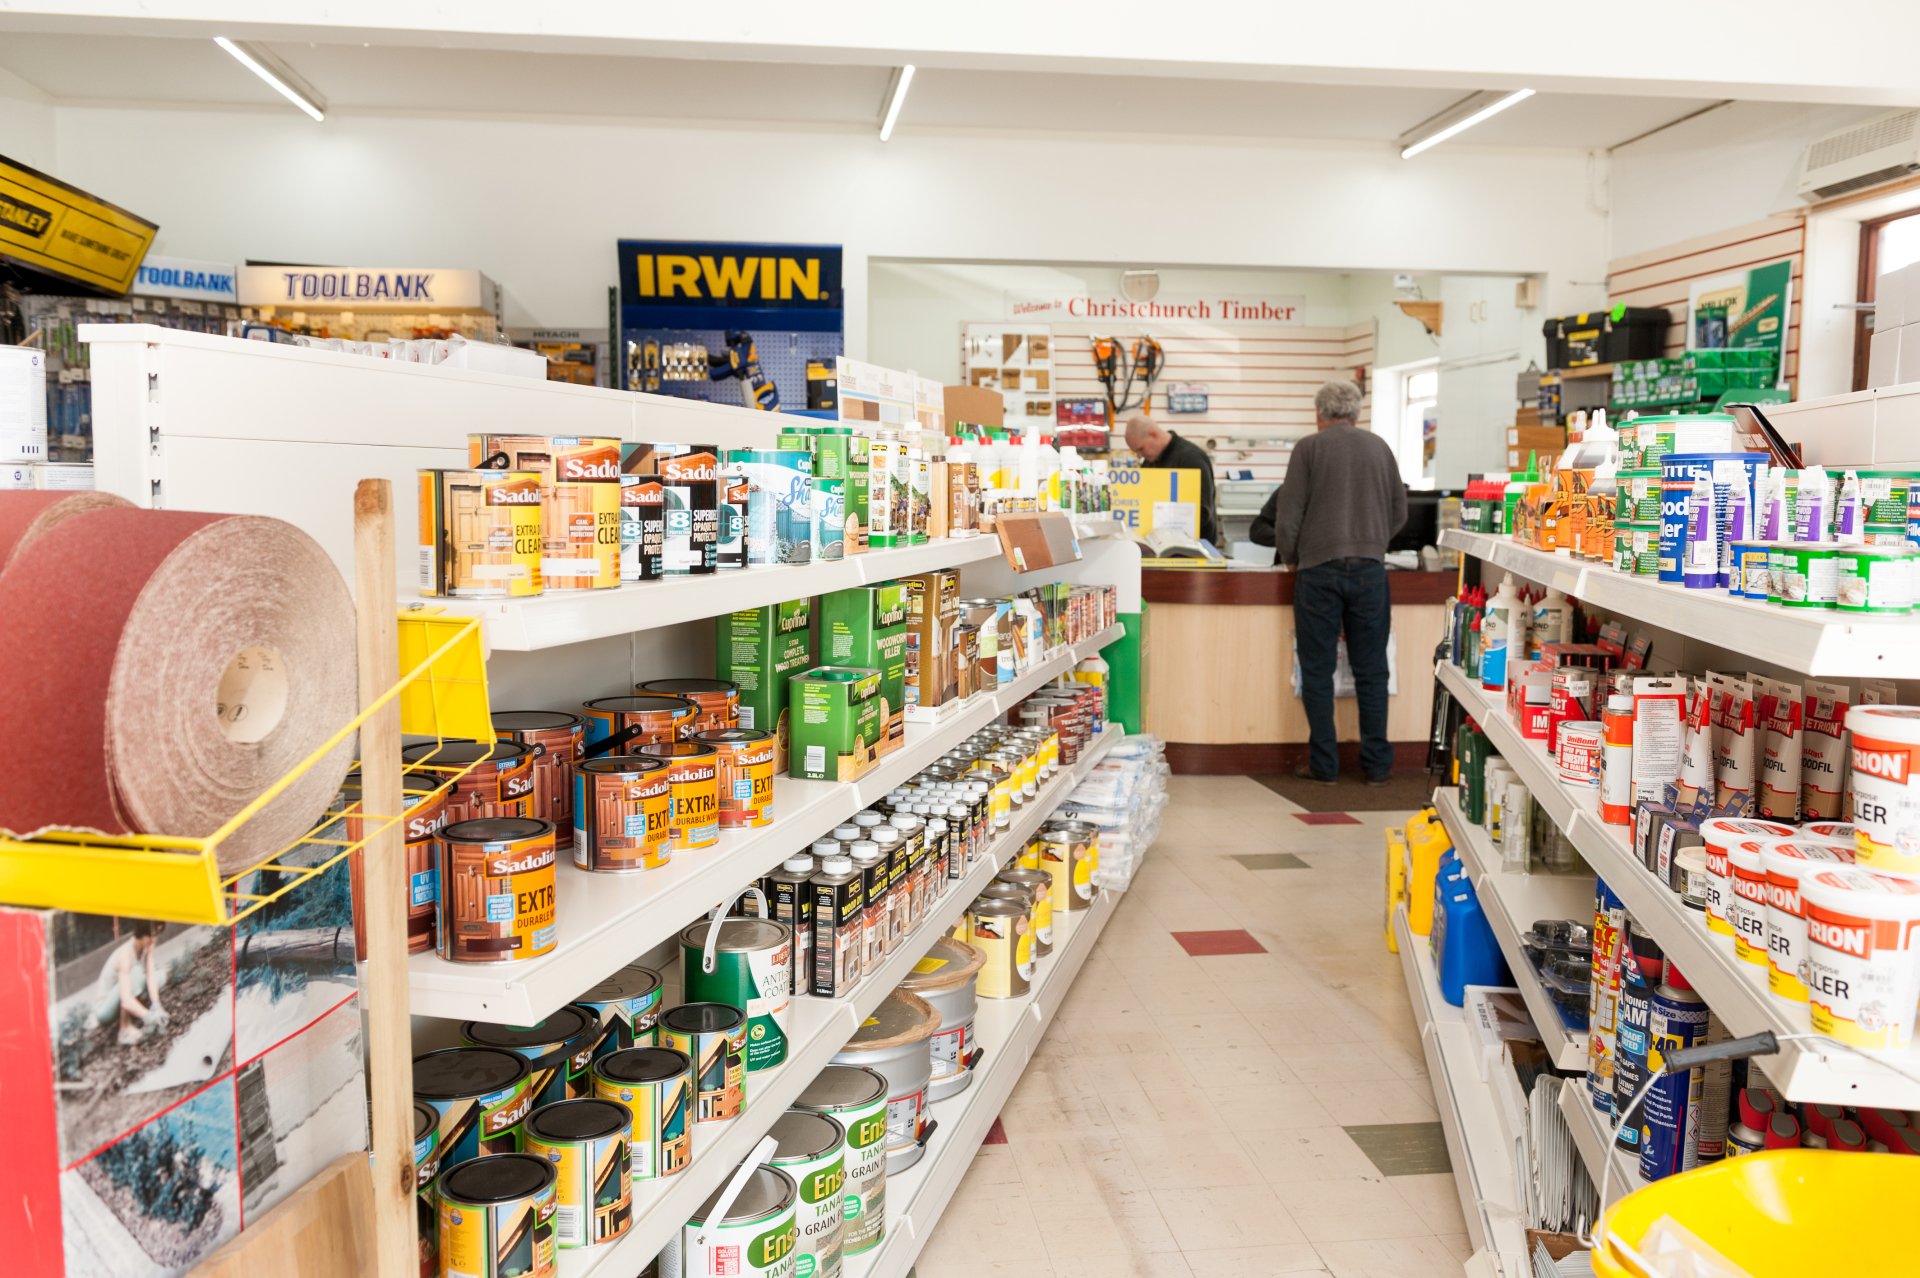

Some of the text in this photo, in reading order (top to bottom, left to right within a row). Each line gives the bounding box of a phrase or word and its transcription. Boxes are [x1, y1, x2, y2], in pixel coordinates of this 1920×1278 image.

[138, 265, 234, 293] TOOLBANK
[637, 254, 821, 300] IRWIN
[283, 271, 434, 301] TOOLBANK
[1069, 297, 1211, 319] Christchurch
[1218, 299, 1296, 321] Timber
[533, 331, 580, 339] HITACHI
[670, 512, 690, 528] 8
[622, 522, 635, 537] 8
[781, 614, 807, 632] Cuprinol
[783, 645, 805, 660] COMPLETE
[884, 646, 901, 660] KILLER
[775, 660, 789, 673] WOOD
[1566, 735, 1598, 746] UniBond
[677, 793, 716, 815] EXTRA
[676, 814, 706, 826] DURABLE
[517, 913, 550, 929] DURABLE
[1810, 920, 1865, 954] RION
[1660, 1006, 1677, 1019] Size
[1651, 1093, 1672, 1104] Moisture
[1652, 1101, 1672, 1112] Protects
[1648, 1116, 1677, 1129] Mechanisms
[1660, 1112, 1673, 1120] Parts
[852, 1162, 880, 1179] GRAIN
[805, 1215, 836, 1238] GRAIN
